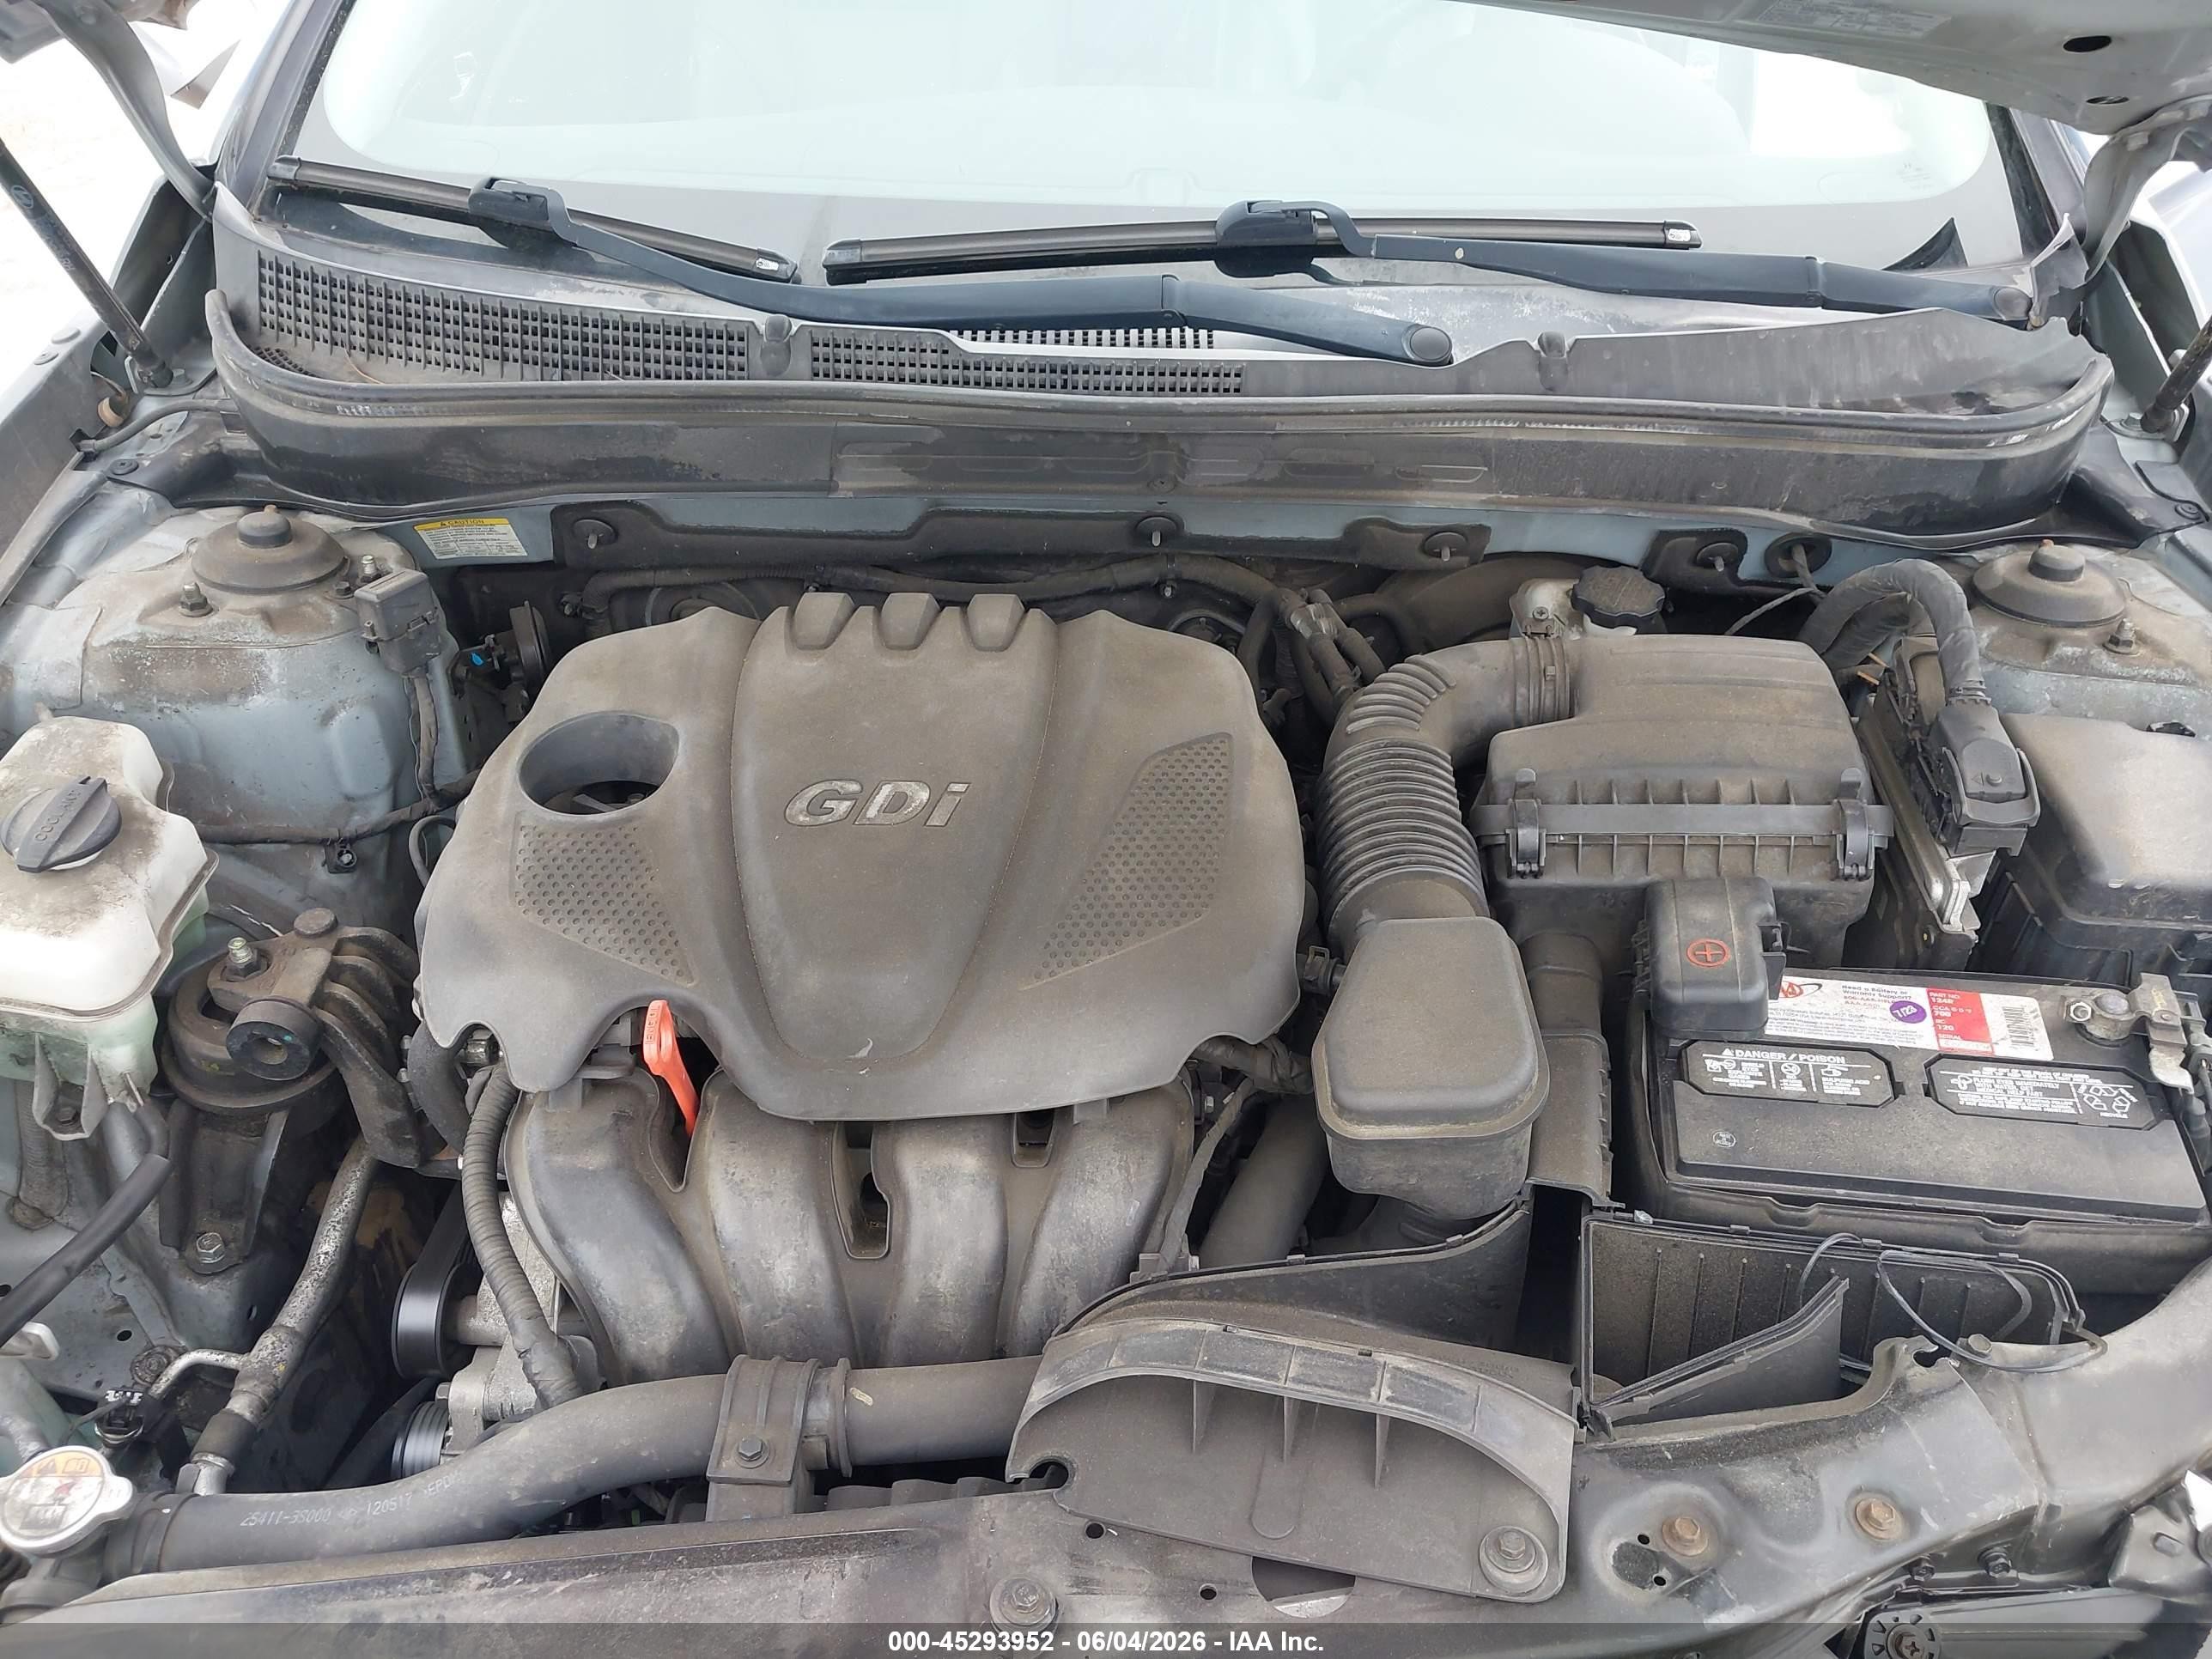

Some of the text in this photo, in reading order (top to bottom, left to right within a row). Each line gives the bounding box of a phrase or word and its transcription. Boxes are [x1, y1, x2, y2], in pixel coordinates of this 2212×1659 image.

[783, 779, 971, 827] GDi
[1735, 1049, 1786, 1060] DANGER
[1798, 1054, 1846, 1064] POISON
